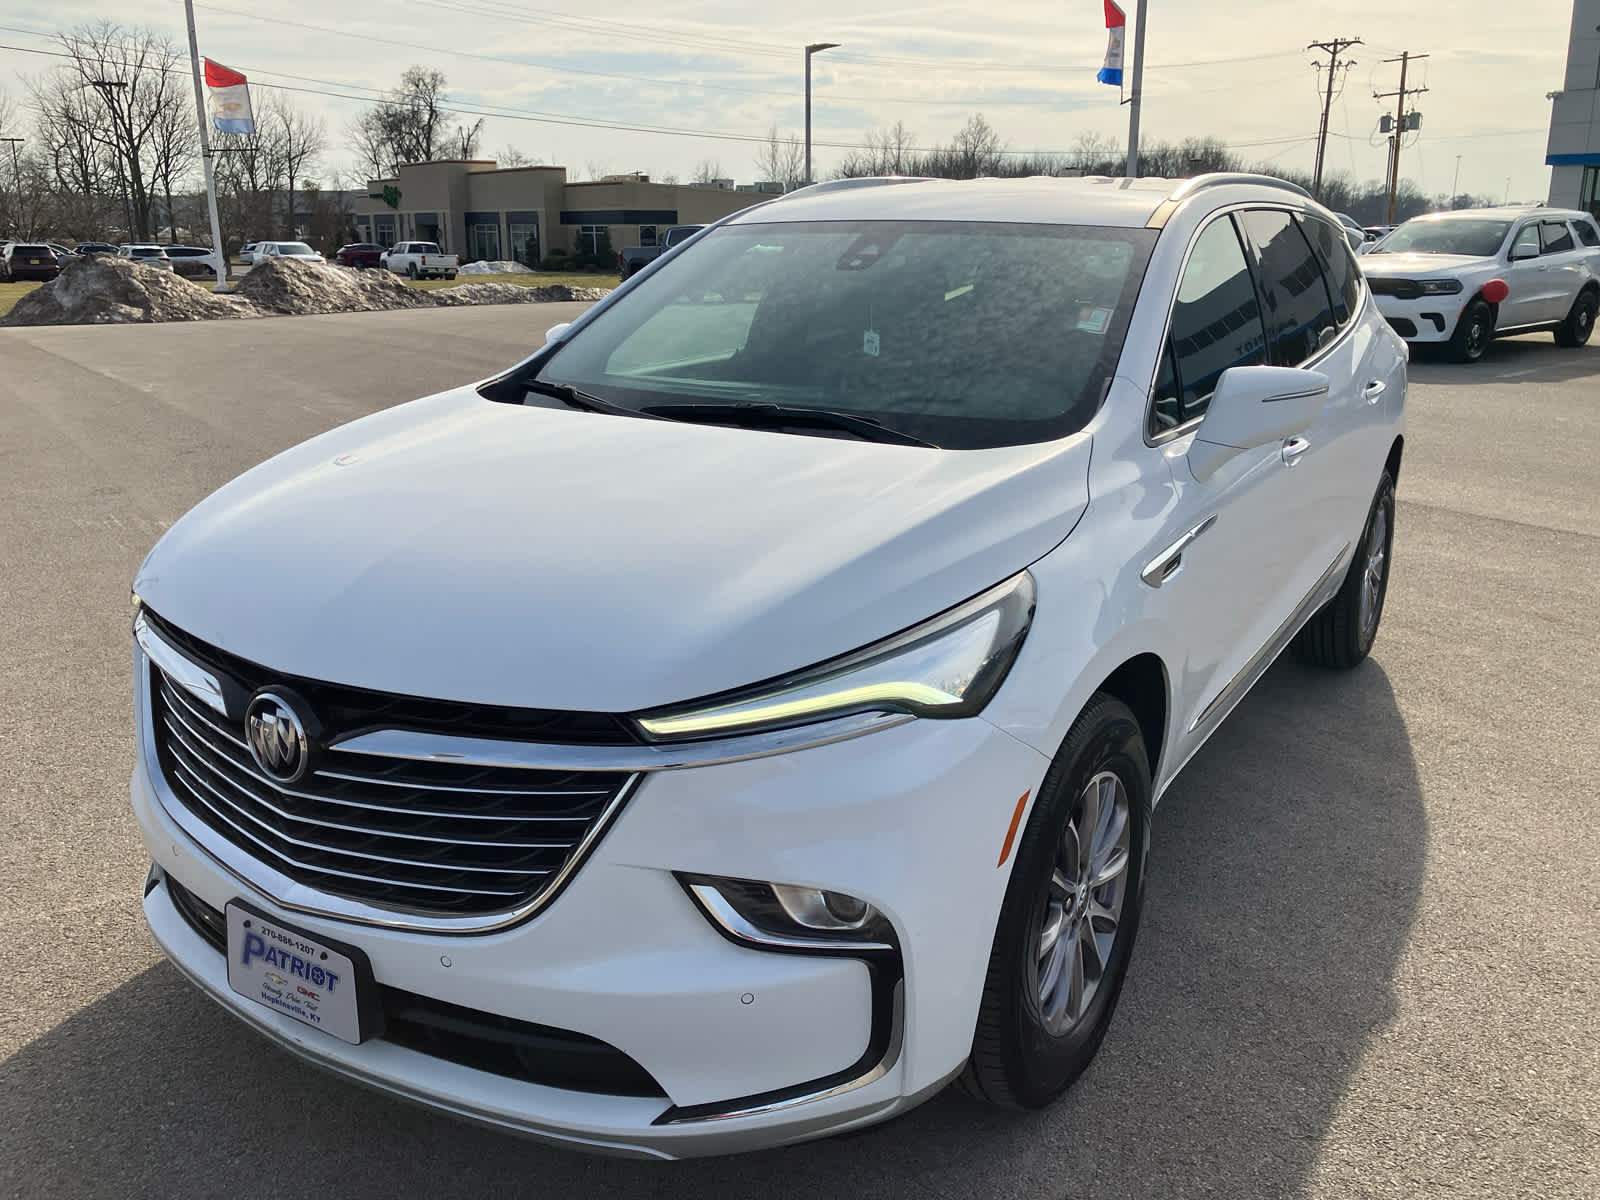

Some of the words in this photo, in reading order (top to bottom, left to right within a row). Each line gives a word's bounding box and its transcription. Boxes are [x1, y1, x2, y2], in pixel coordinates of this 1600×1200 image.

[242, 931, 339, 993] PATRIOT
[296, 985, 321, 1002] GMC
[310, 1011, 321, 1023] KY
